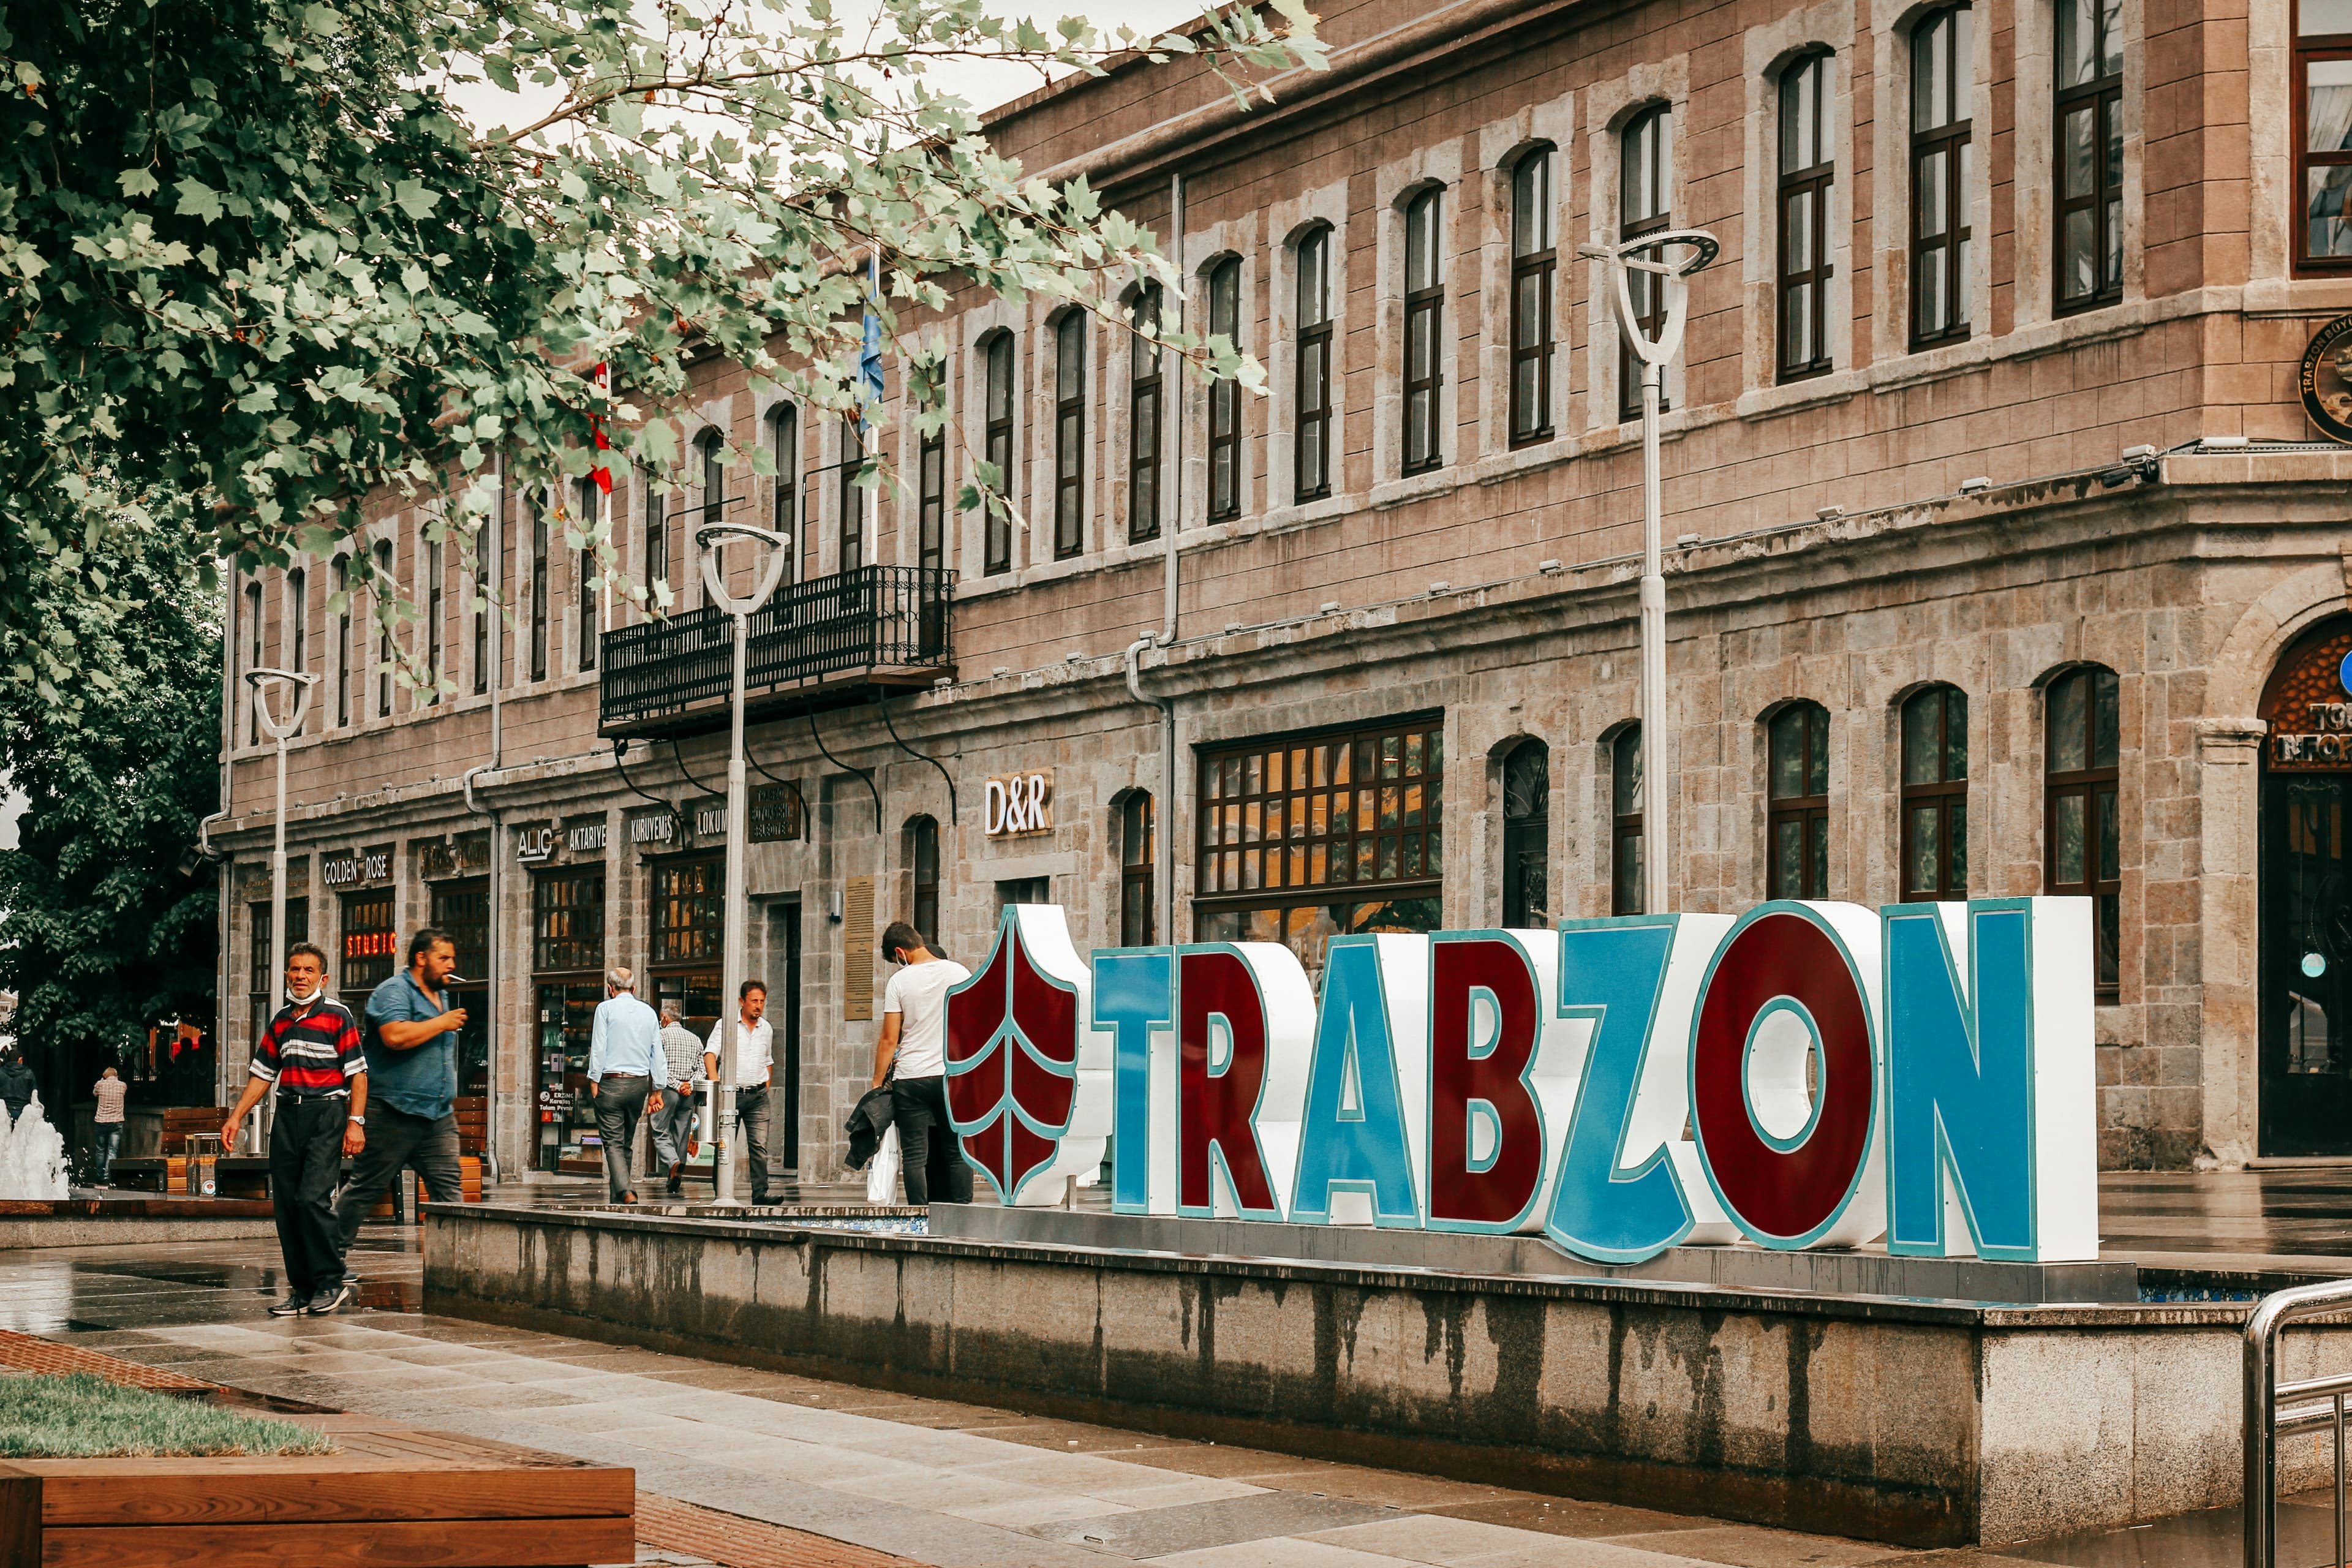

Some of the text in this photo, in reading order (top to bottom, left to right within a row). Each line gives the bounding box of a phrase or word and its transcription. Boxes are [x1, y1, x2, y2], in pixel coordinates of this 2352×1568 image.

[2303, 337, 2326, 394] TRABZON
[985, 774, 1045, 835] D&R
[324, 854, 386, 885] GOLDEN ROSE
[1092, 896, 2037, 1264] TRABZON
